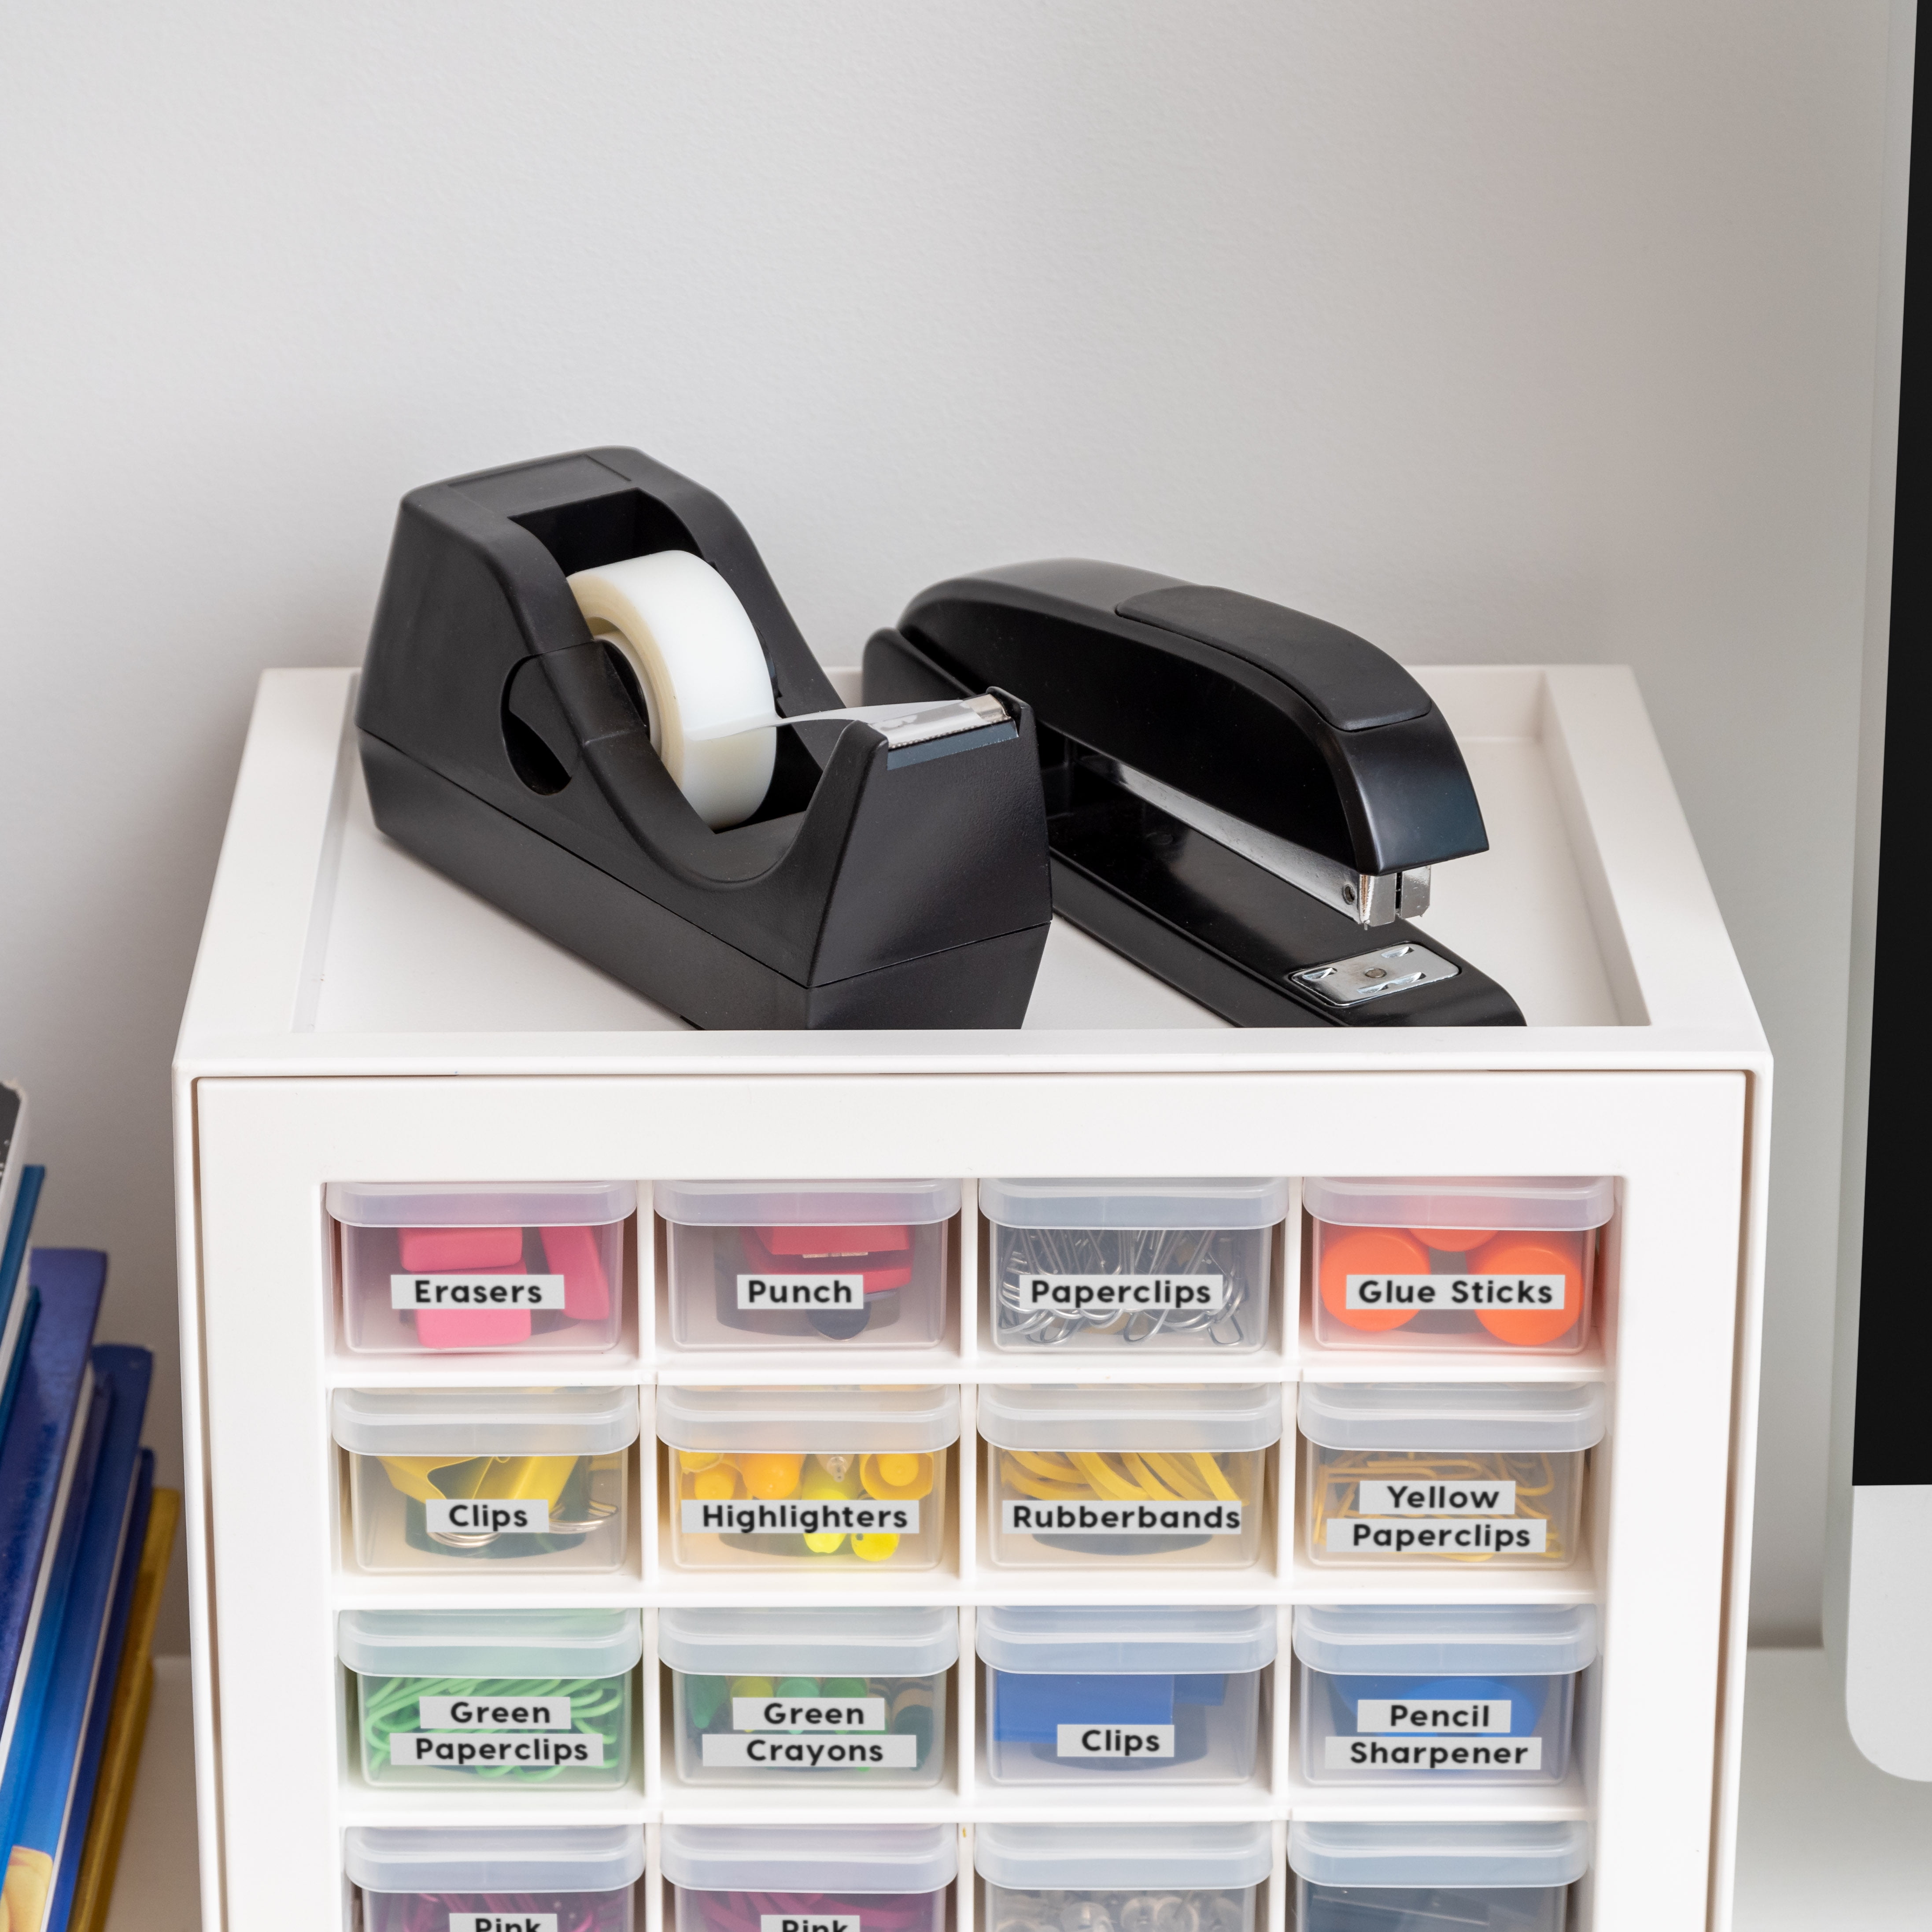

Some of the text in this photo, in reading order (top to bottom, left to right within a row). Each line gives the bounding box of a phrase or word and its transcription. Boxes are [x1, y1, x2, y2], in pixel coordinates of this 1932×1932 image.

[415, 1280, 542, 1303] Erasers
[749, 1280, 851, 1303] Punch
[1032, 1280, 1211, 1308] Paperclips
[1359, 1280, 1552, 1304] Glue Sticks
[1387, 1486, 1499, 1508] Yellow
[449, 1504, 528, 1532] Clips
[703, 1505, 907, 1534] Highlighters
[1014, 1505, 1240, 1529] Rubberbands
[1353, 1524, 1530, 1552] Paperclips
[451, 1701, 550, 1723] Green
[764, 1703, 864, 1725] Green
[1391, 1705, 1489, 1727] Pencil
[416, 1738, 588, 1765] Paperclips
[746, 1739, 883, 1766] Crayons
[1082, 1729, 1160, 1756] Clips
[1351, 1742, 1528, 1769] Sharpener
